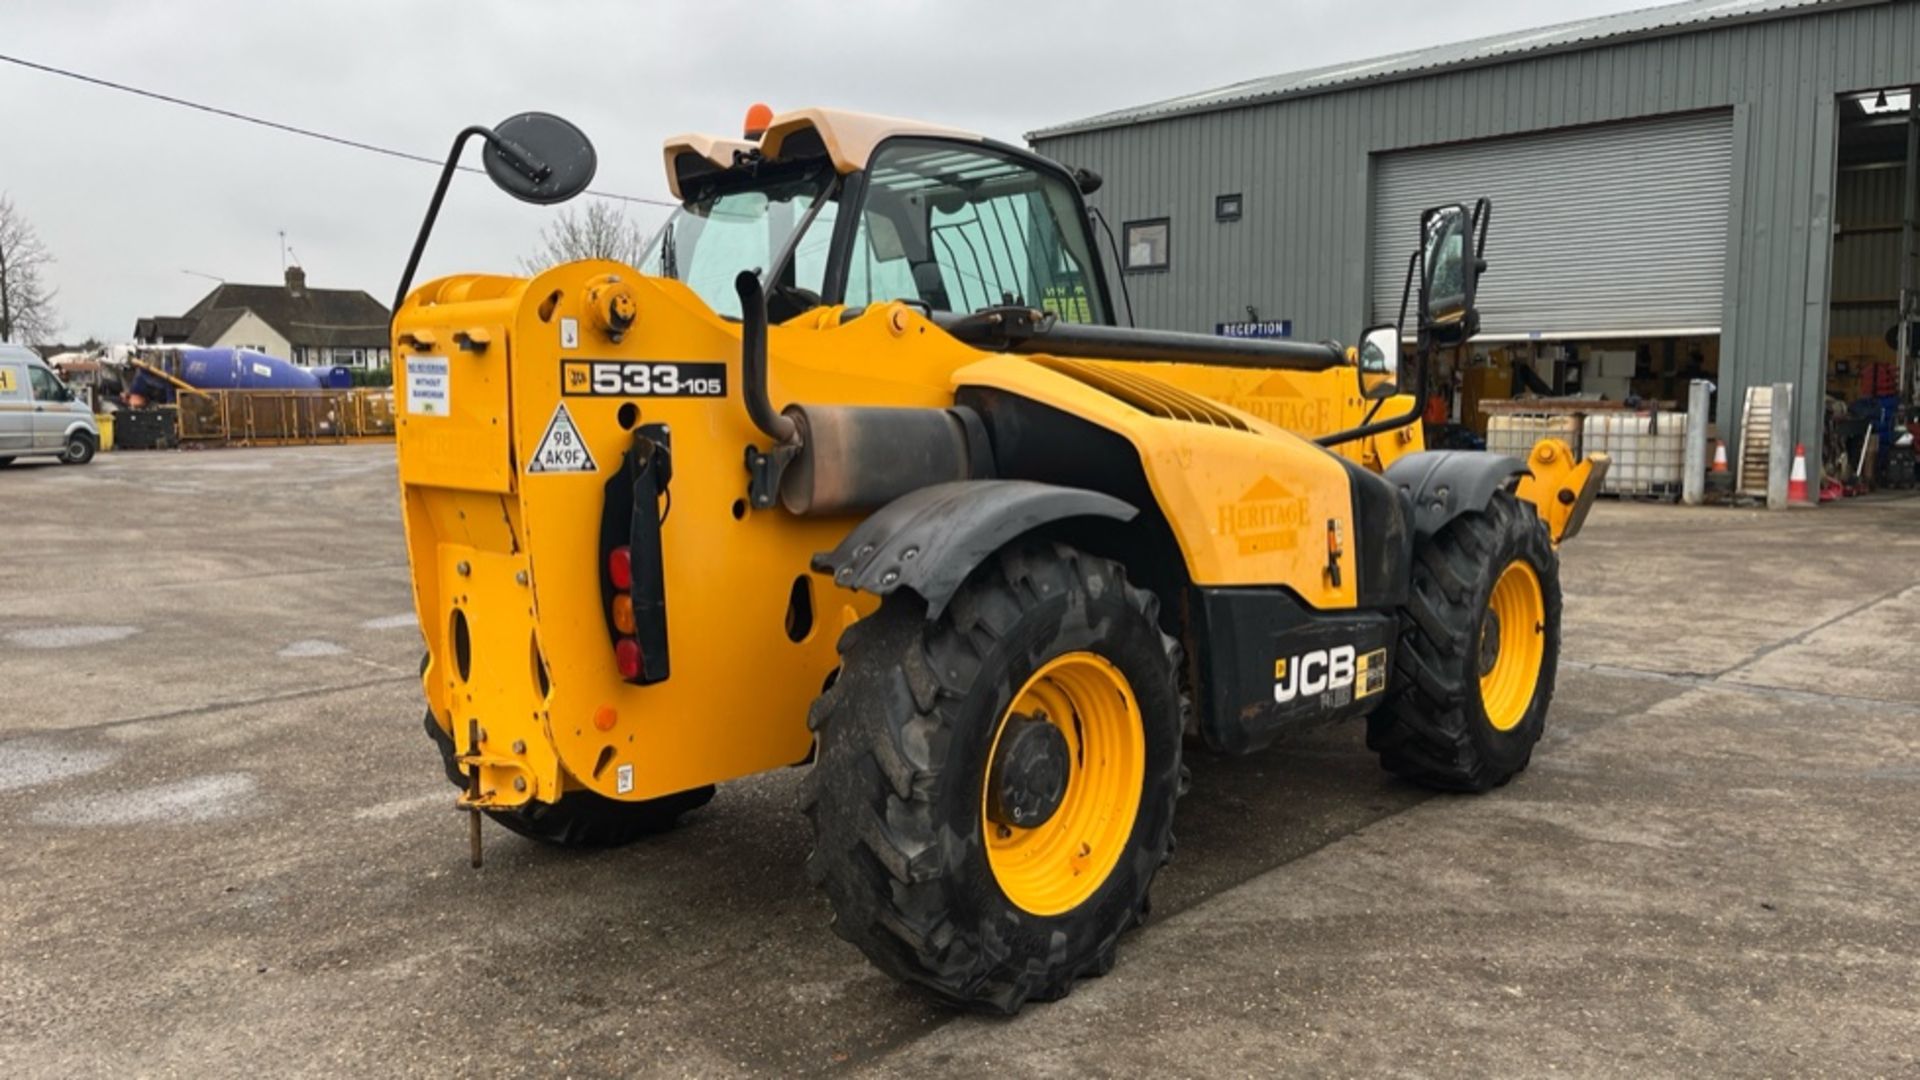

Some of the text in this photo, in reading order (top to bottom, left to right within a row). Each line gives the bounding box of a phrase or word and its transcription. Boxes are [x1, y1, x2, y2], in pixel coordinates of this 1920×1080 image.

[1224, 321, 1283, 337] RECEPTION
[593, 363, 722, 394] 533-105
[553, 431, 572, 446] 98
[545, 449, 581, 465] AK9F
[1218, 496, 1311, 536] HERITAGE
[1274, 644, 1356, 703] JCB
